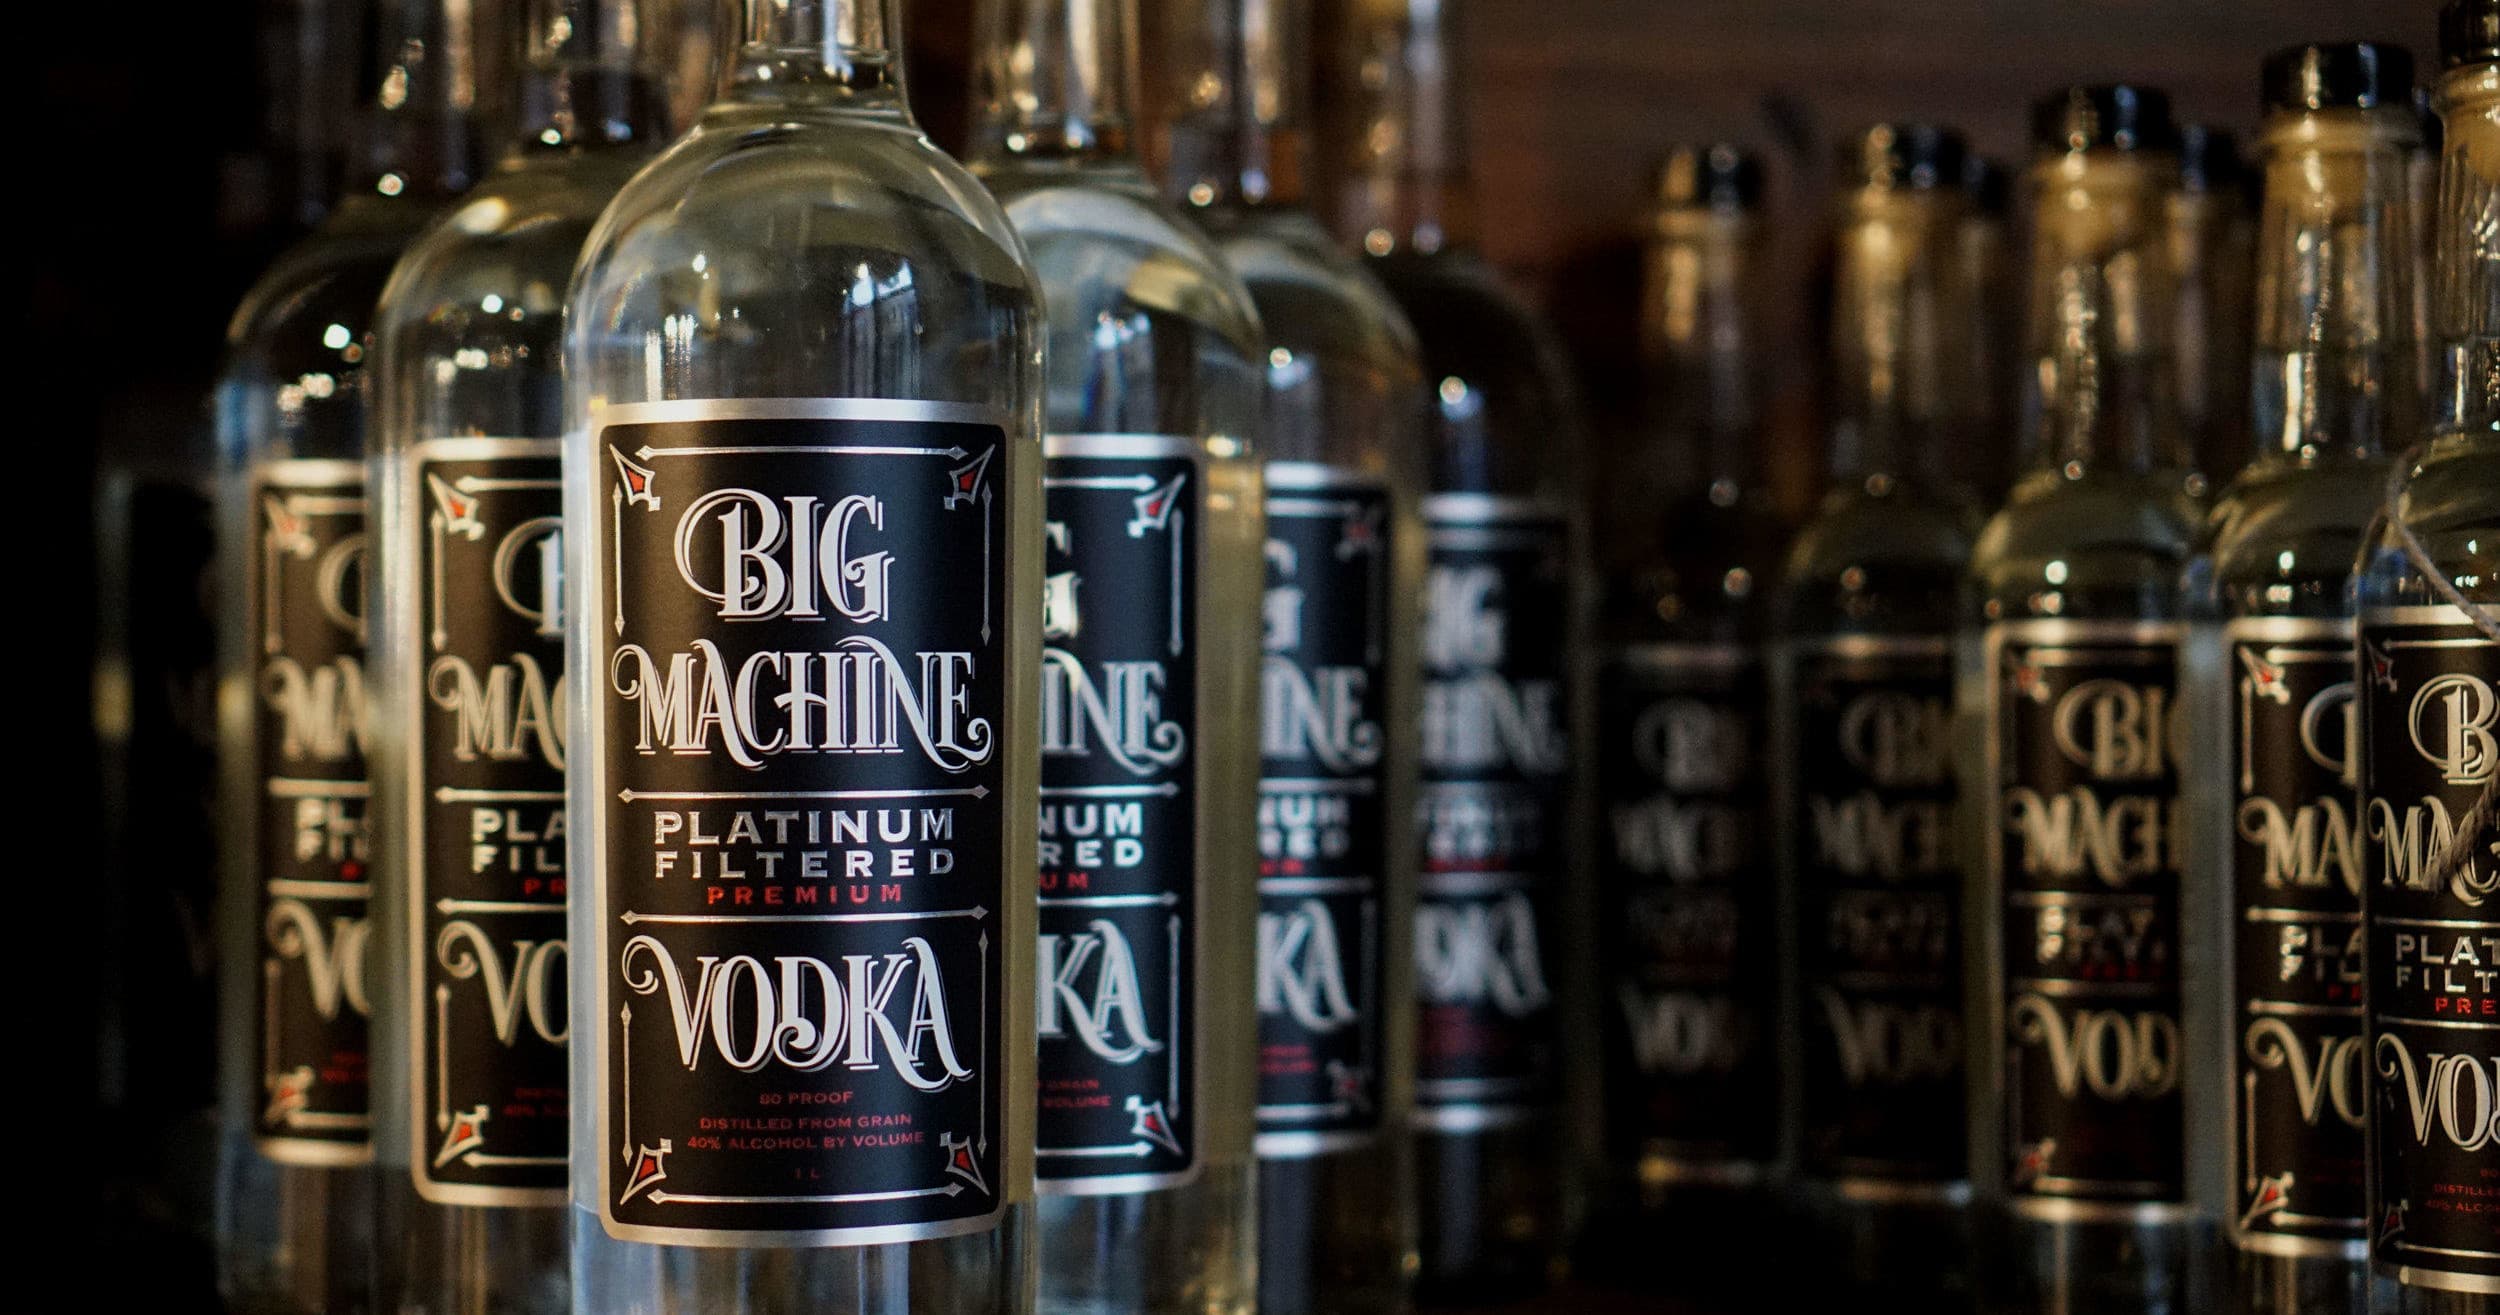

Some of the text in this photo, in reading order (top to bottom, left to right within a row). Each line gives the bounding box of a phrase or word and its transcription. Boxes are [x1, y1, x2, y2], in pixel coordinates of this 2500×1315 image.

[674, 488, 895, 623] BIG
[428, 653, 566, 771] MA
[611, 636, 994, 773] MACHINE
[654, 808, 954, 846] PLATINUM
[654, 848, 955, 879] FILTERED
[707, 884, 902, 906] PREMIUM
[2396, 966, 2498, 993] FILT
[621, 934, 975, 1093] VODKA
[2435, 997, 2496, 1016] PRE
[759, 1091, 854, 1105] 80 PROOF
[2376, 1033, 2500, 1151] VO
[700, 1113, 912, 1131] DISTILLED FROM GRAIN
[687, 1131, 925, 1151] 40% ALCOHOL BY VOLUME
